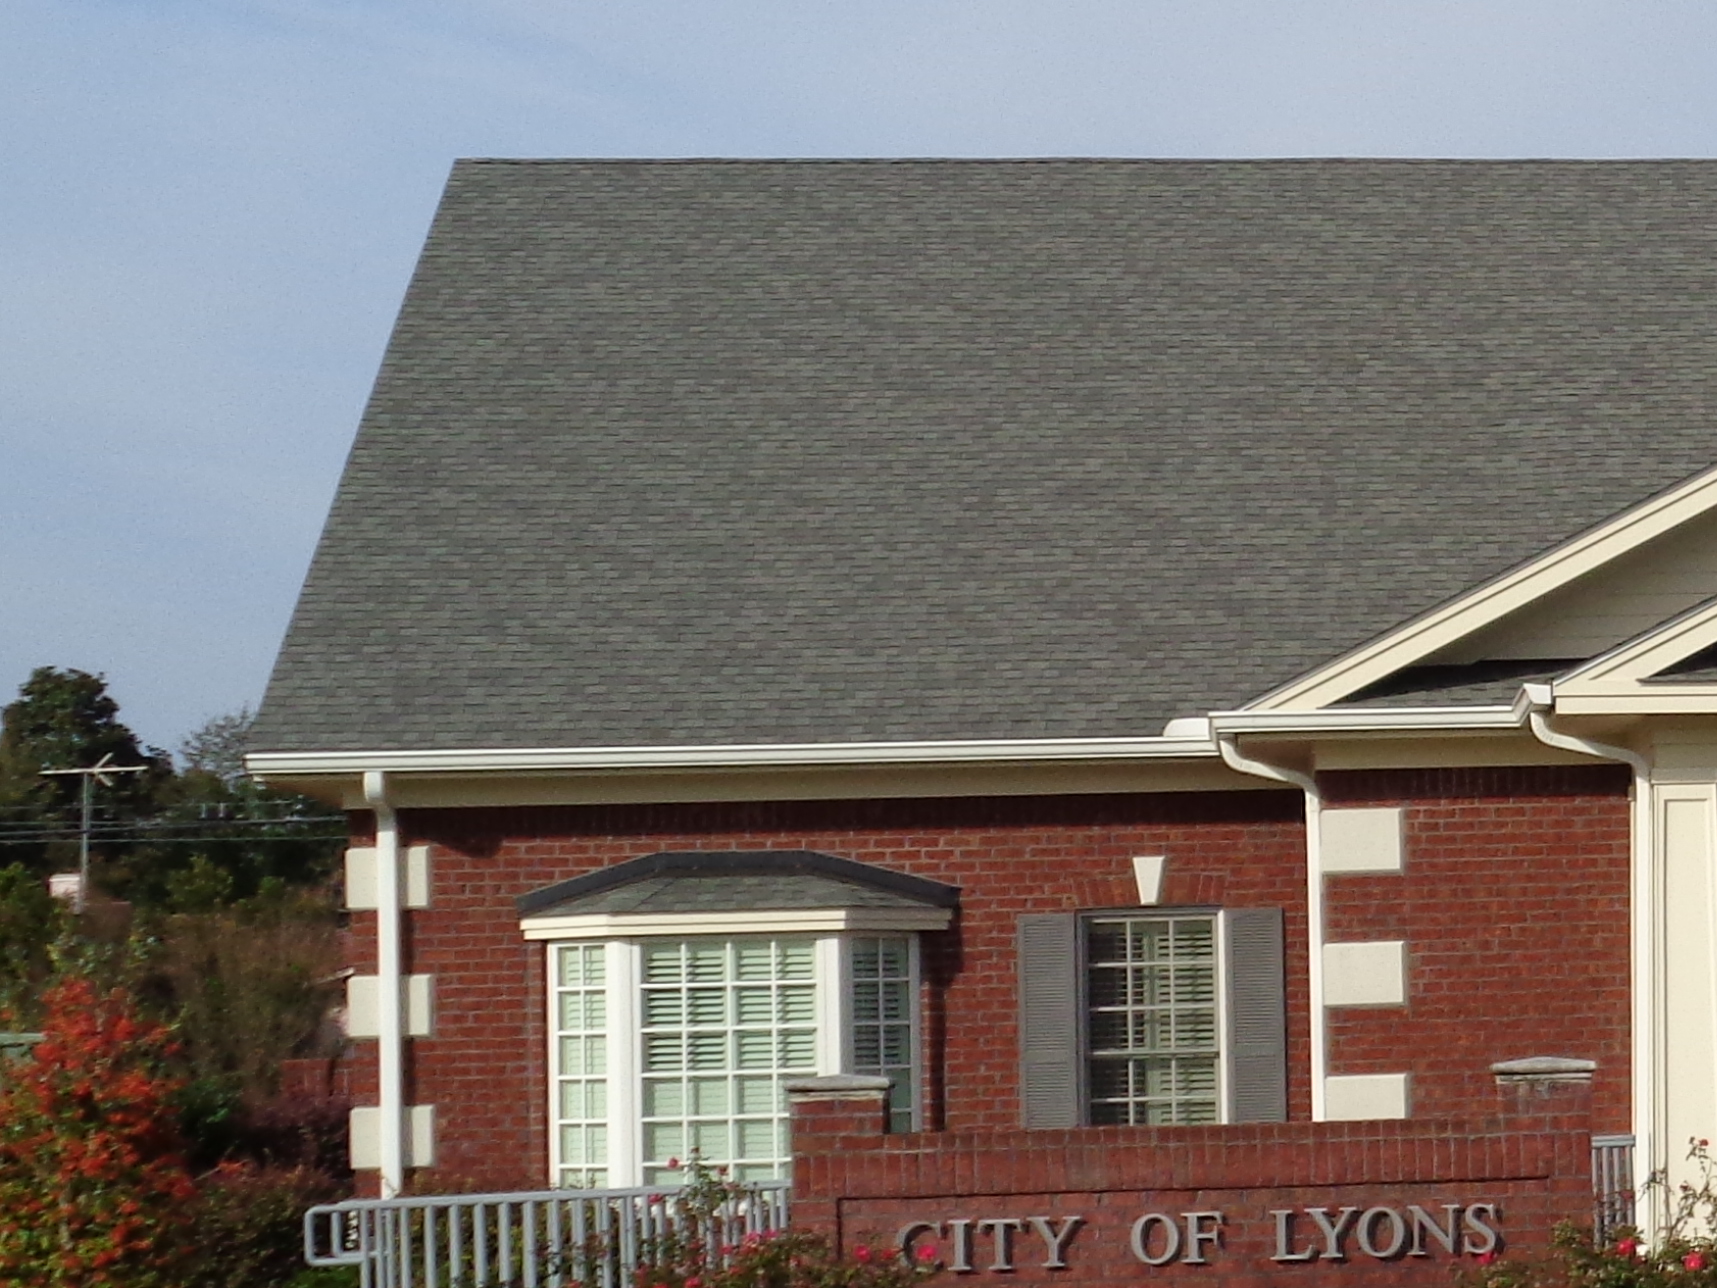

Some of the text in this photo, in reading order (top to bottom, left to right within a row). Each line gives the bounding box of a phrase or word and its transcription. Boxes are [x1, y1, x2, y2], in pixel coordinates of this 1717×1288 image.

[896, 1202, 1498, 1272] CITY OF LYONS
